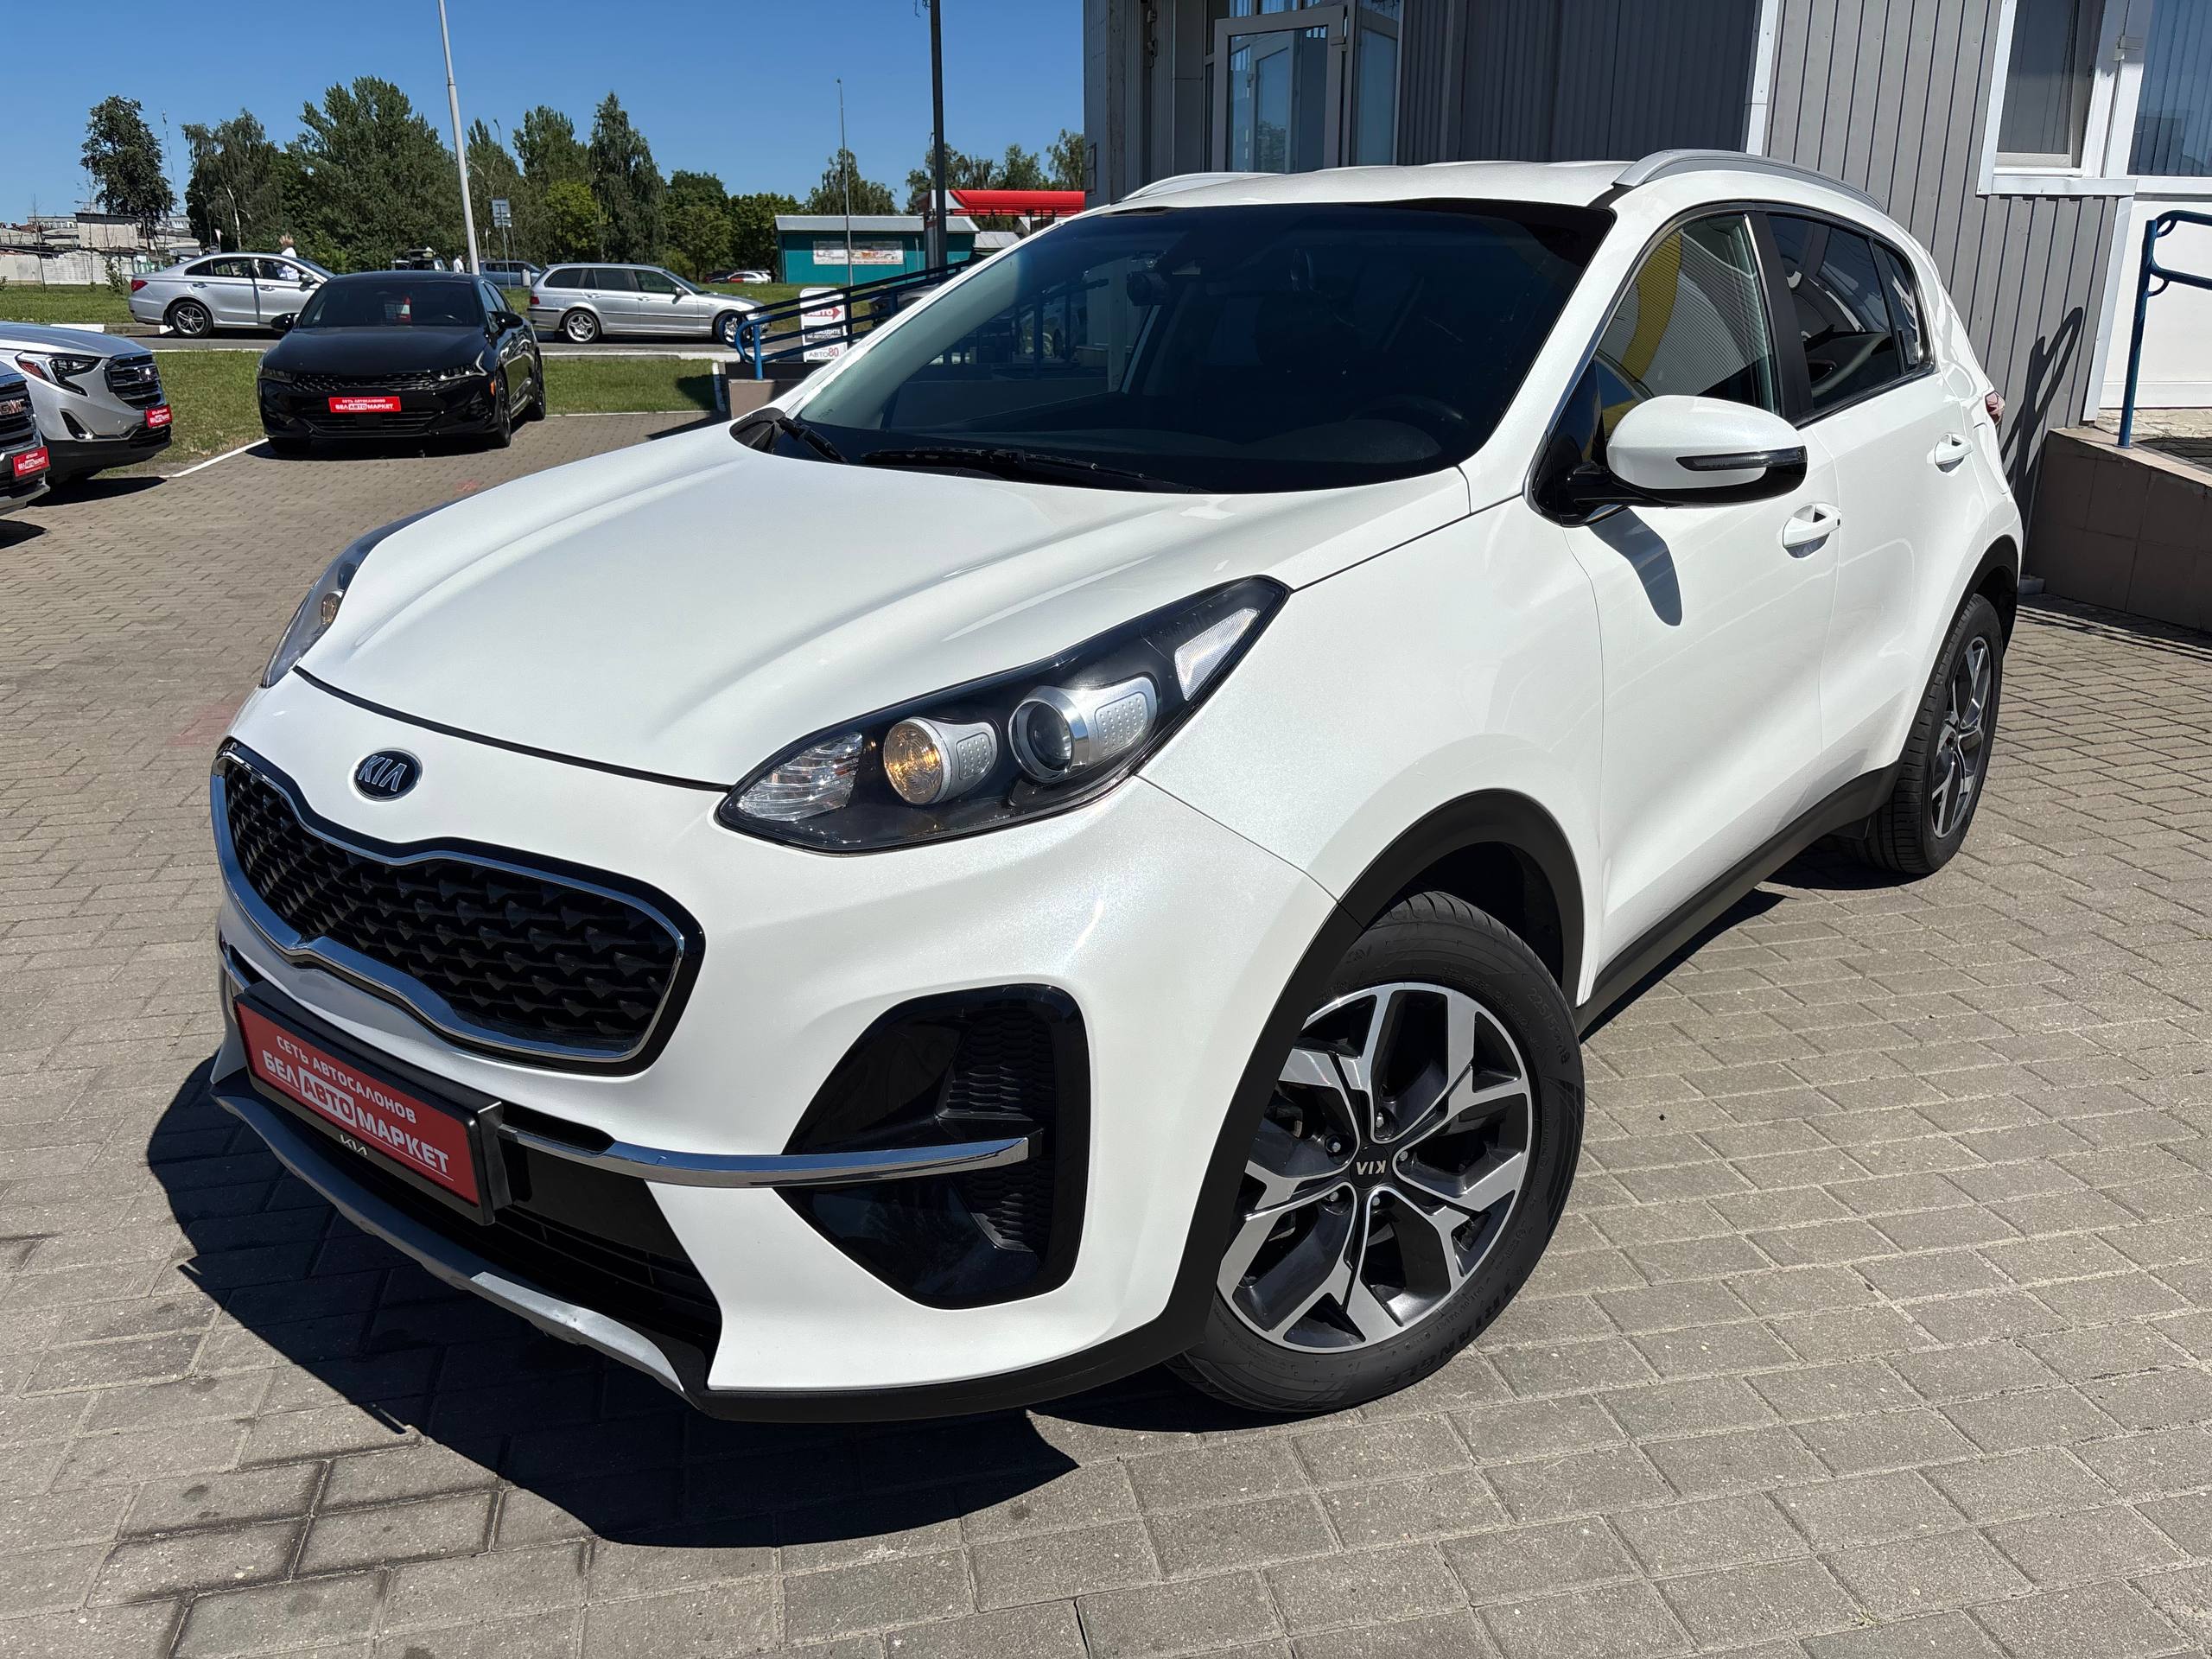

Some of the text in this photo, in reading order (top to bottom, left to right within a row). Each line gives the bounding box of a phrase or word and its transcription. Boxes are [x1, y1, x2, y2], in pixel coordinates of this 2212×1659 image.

[358, 755, 408, 792] KIA
[276, 1034, 416, 1125] СЕТЬ АВТОСАЛОНОВ
[340, 1134, 368, 1157] KIA
[1356, 1160, 1387, 1176] KIA
[1381, 1282, 1515, 1389] TRIANGLE
